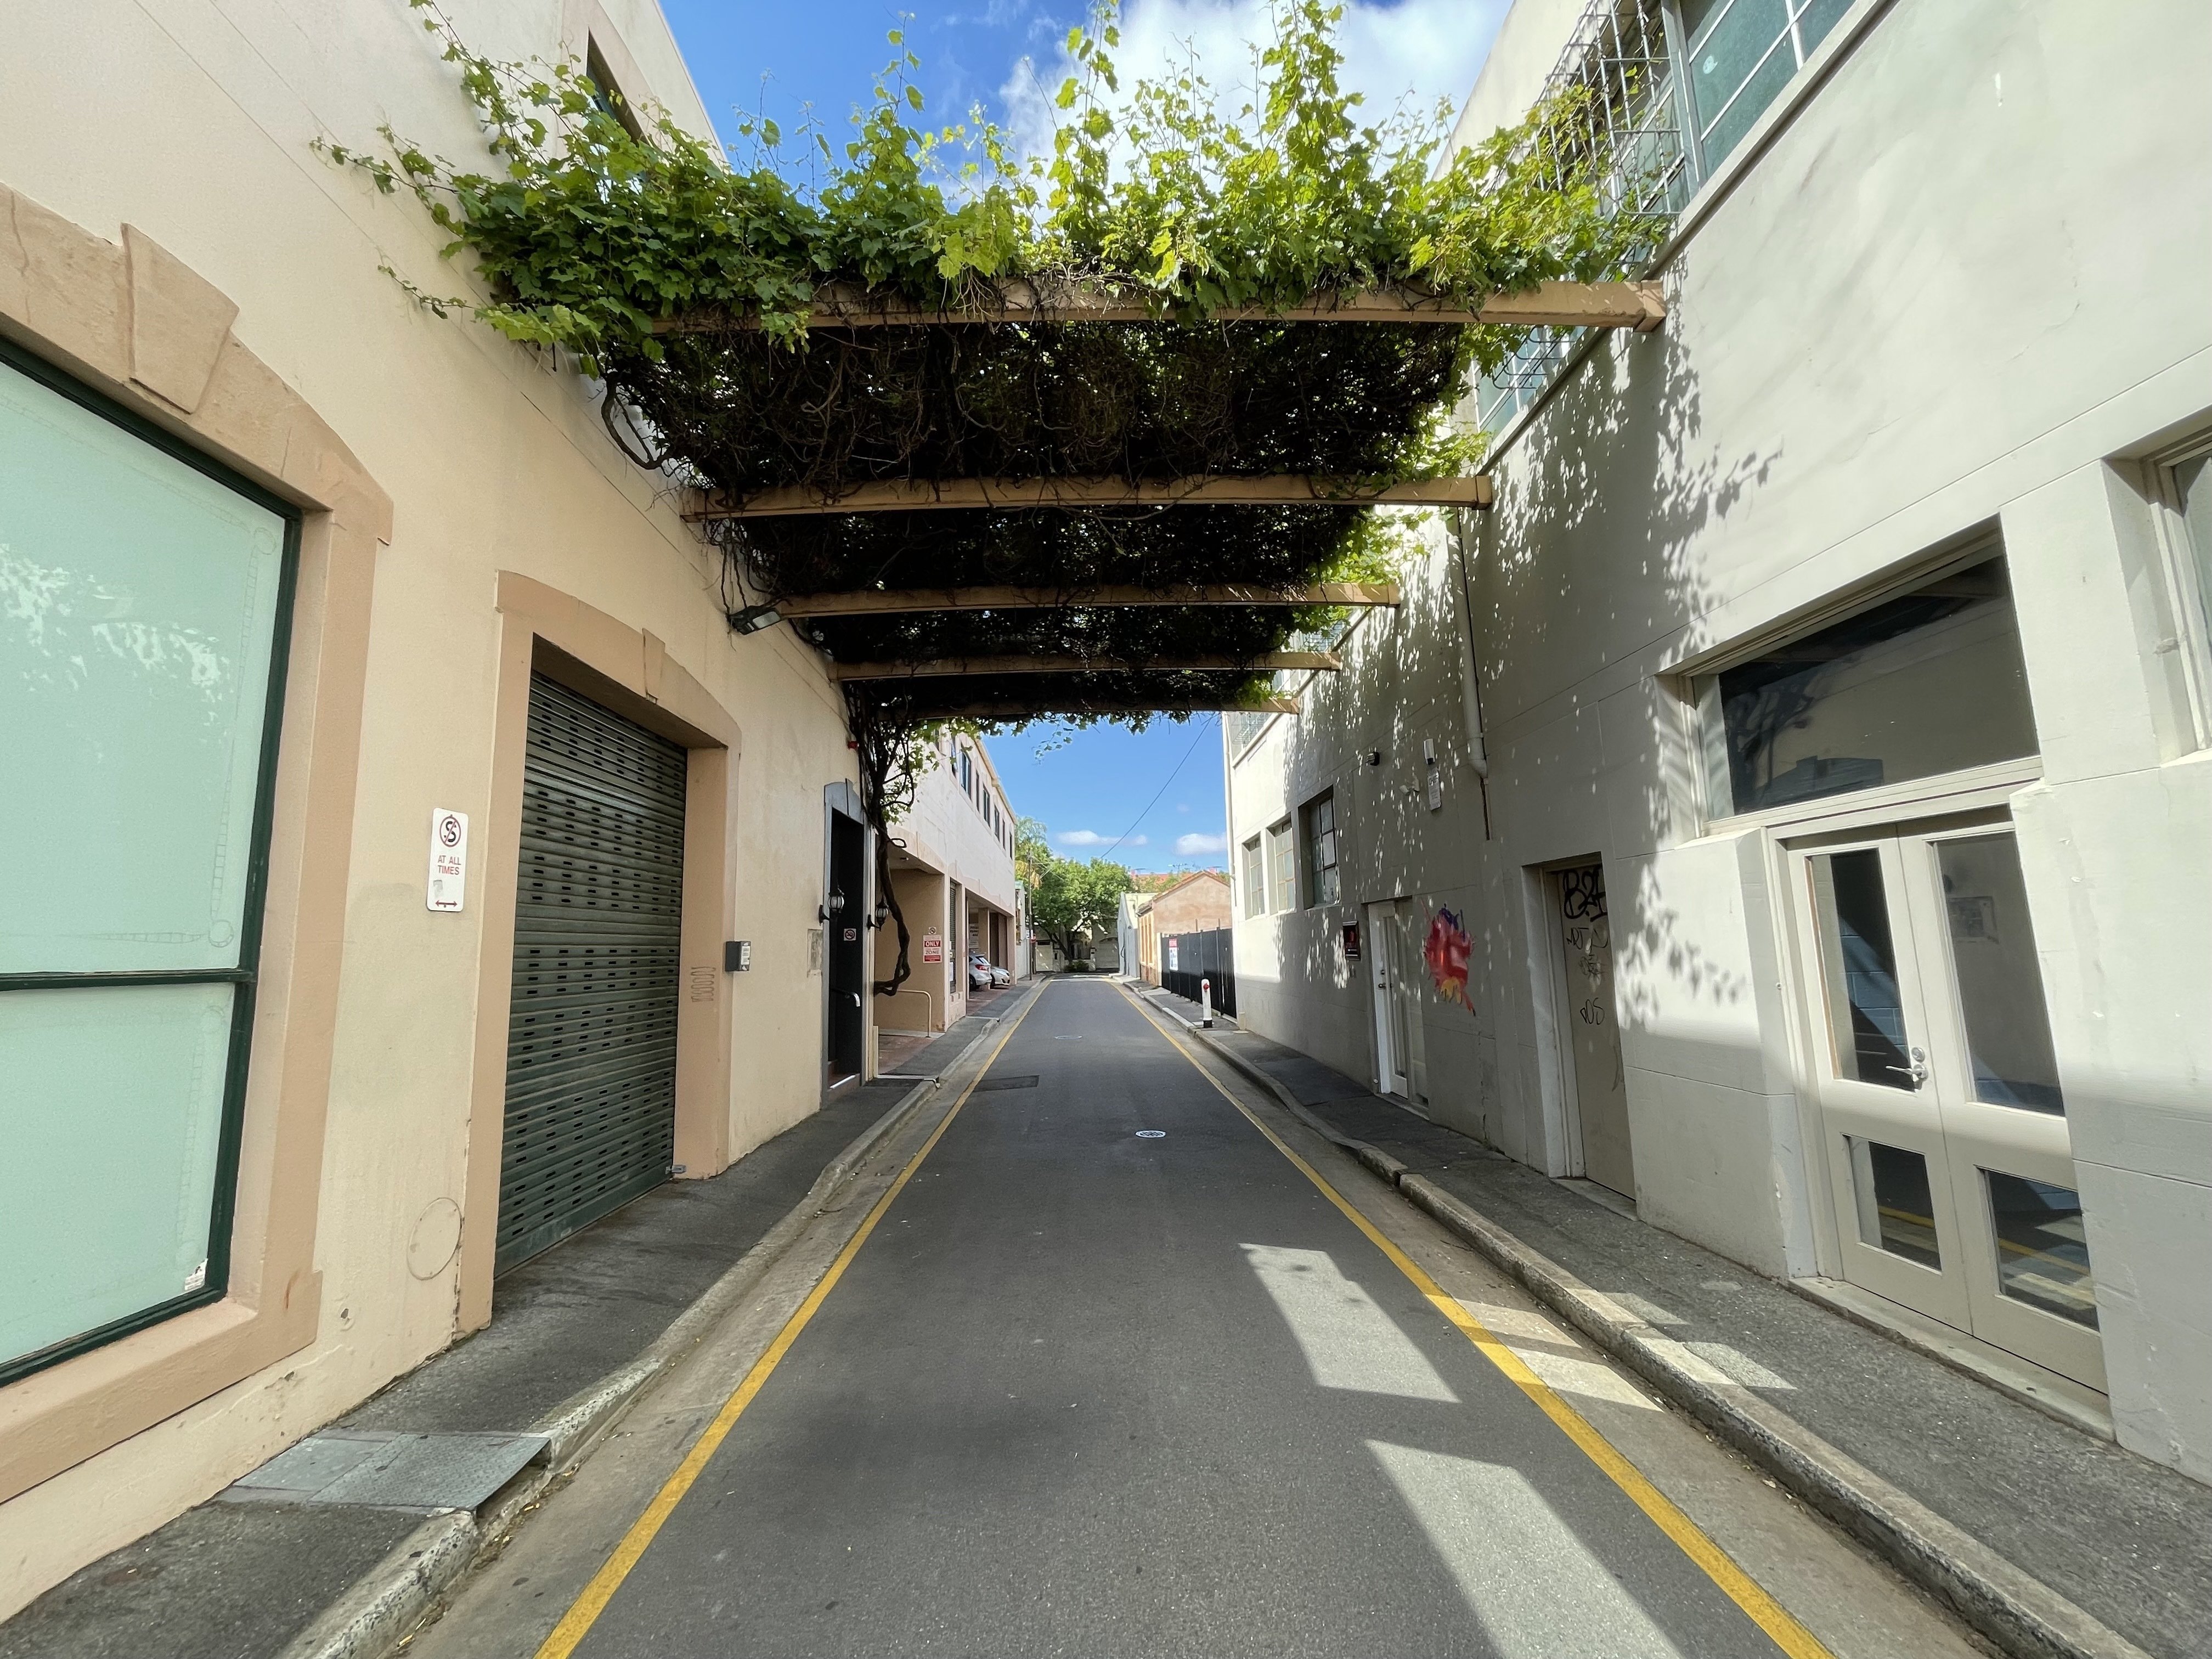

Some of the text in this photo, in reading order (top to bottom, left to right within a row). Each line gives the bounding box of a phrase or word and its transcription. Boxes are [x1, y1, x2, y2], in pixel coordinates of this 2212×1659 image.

[438, 855, 461, 865] AT ALL
[438, 865, 460, 875] TIMES
